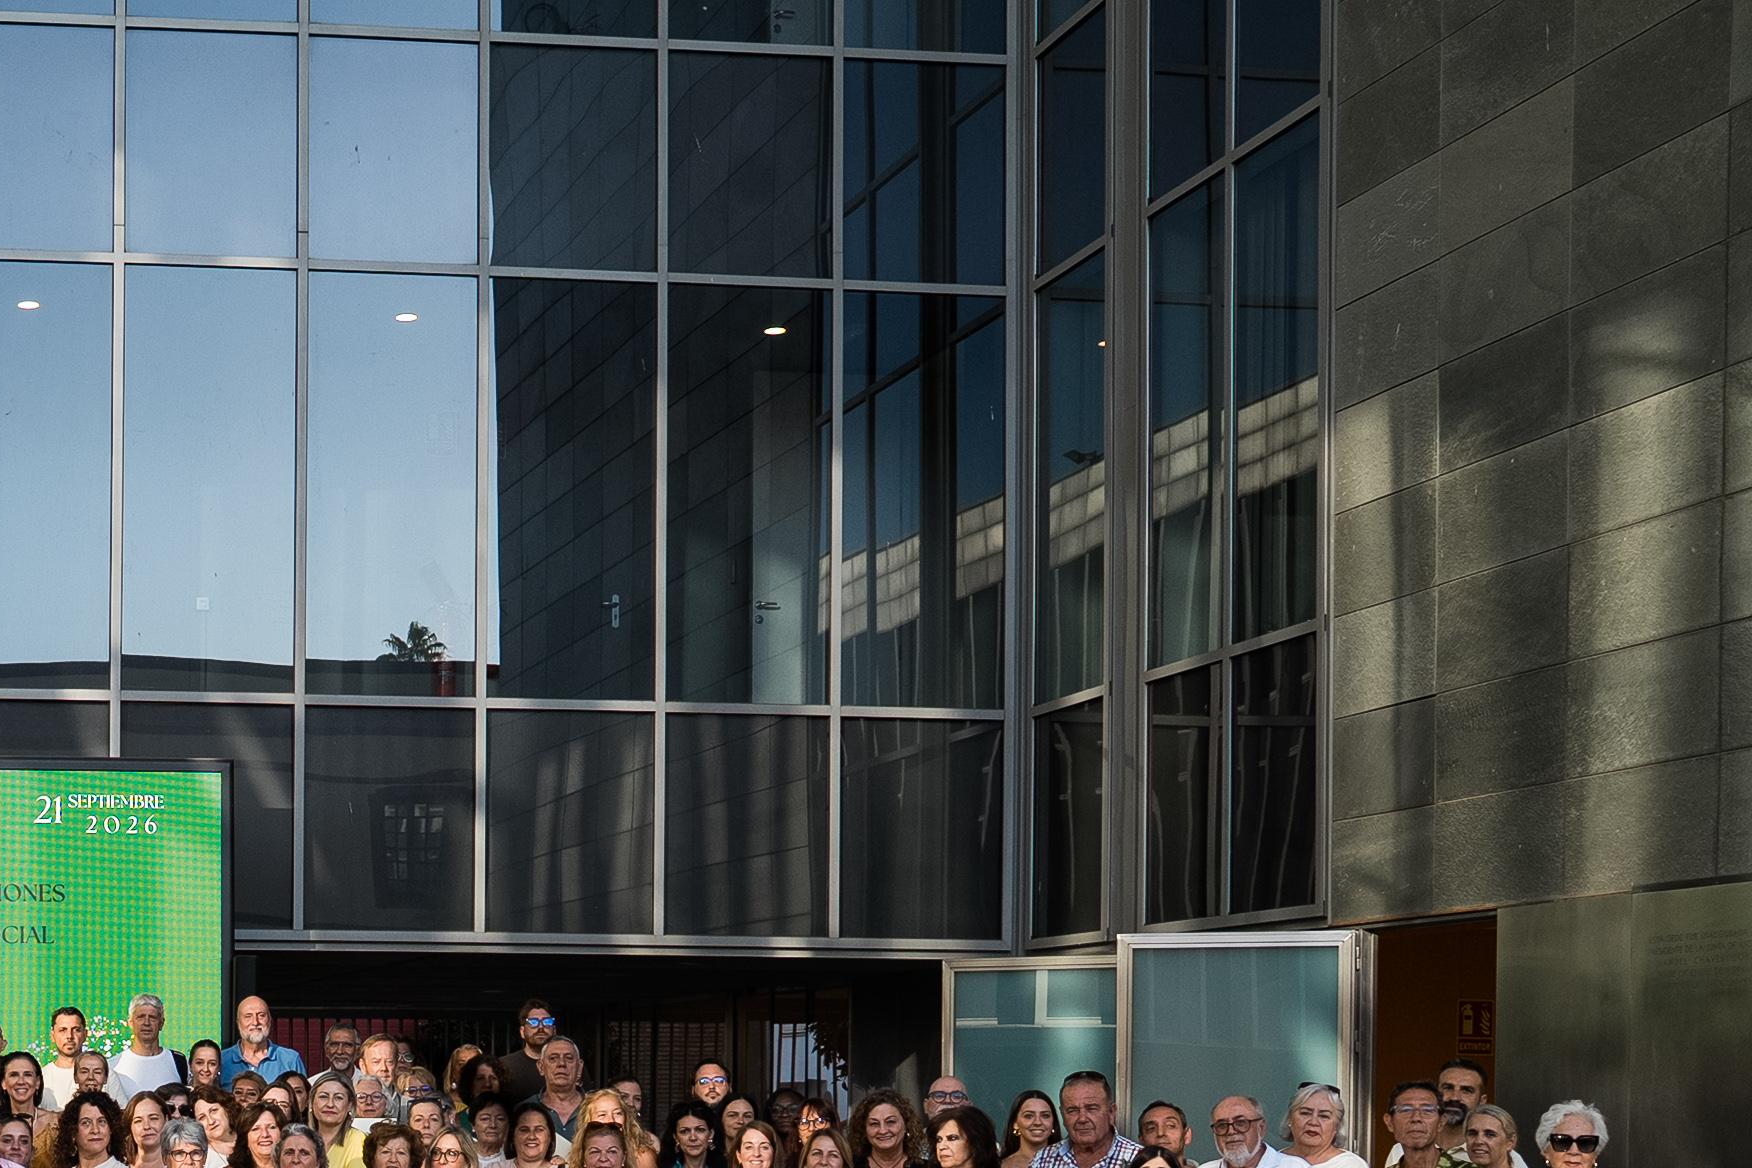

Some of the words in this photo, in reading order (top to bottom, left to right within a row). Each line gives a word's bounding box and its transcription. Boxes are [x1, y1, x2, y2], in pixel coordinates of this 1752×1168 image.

[33, 795, 63, 824] 21
[68, 794, 165, 809] SEPTIEMBRE
[86, 814, 158, 834] 2026
